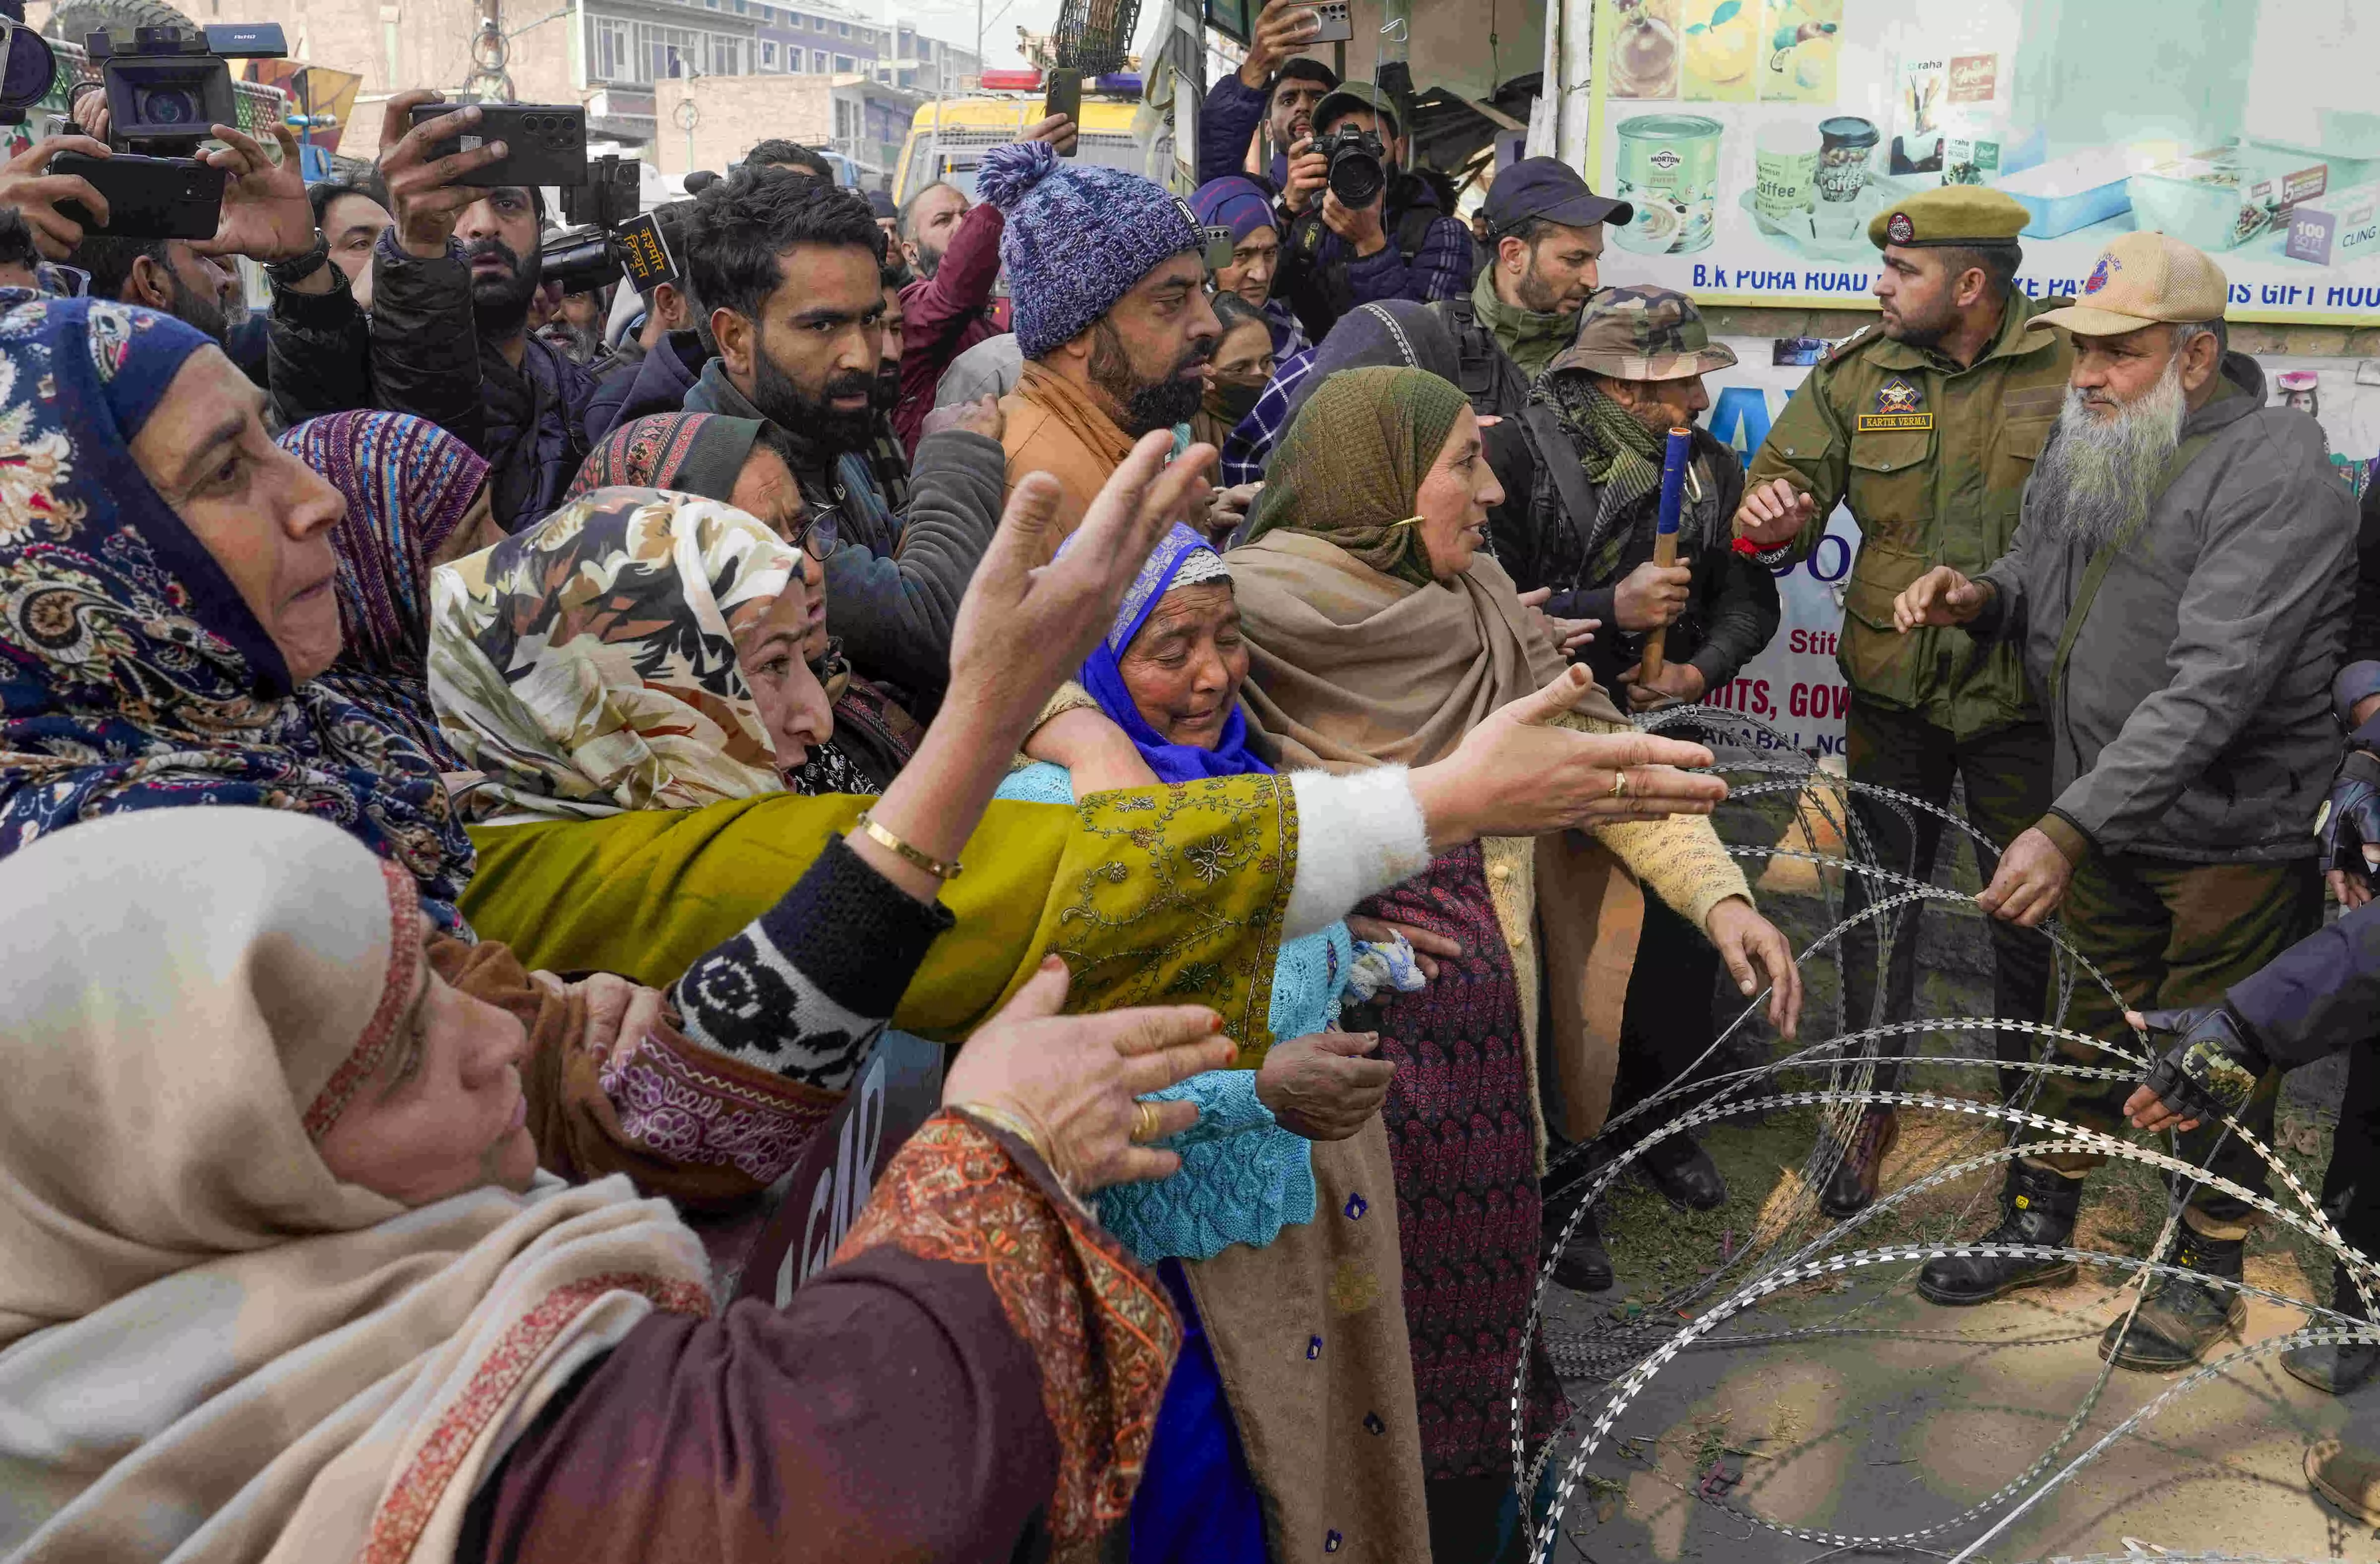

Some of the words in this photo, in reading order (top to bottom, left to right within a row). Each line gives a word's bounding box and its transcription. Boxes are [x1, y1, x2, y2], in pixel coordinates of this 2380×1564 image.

[2296, 221, 2325, 239] 100
[2342, 226, 2377, 247] CLING
[1866, 417, 1897, 427] KARTIK
[1899, 416, 1926, 426] VERMA
